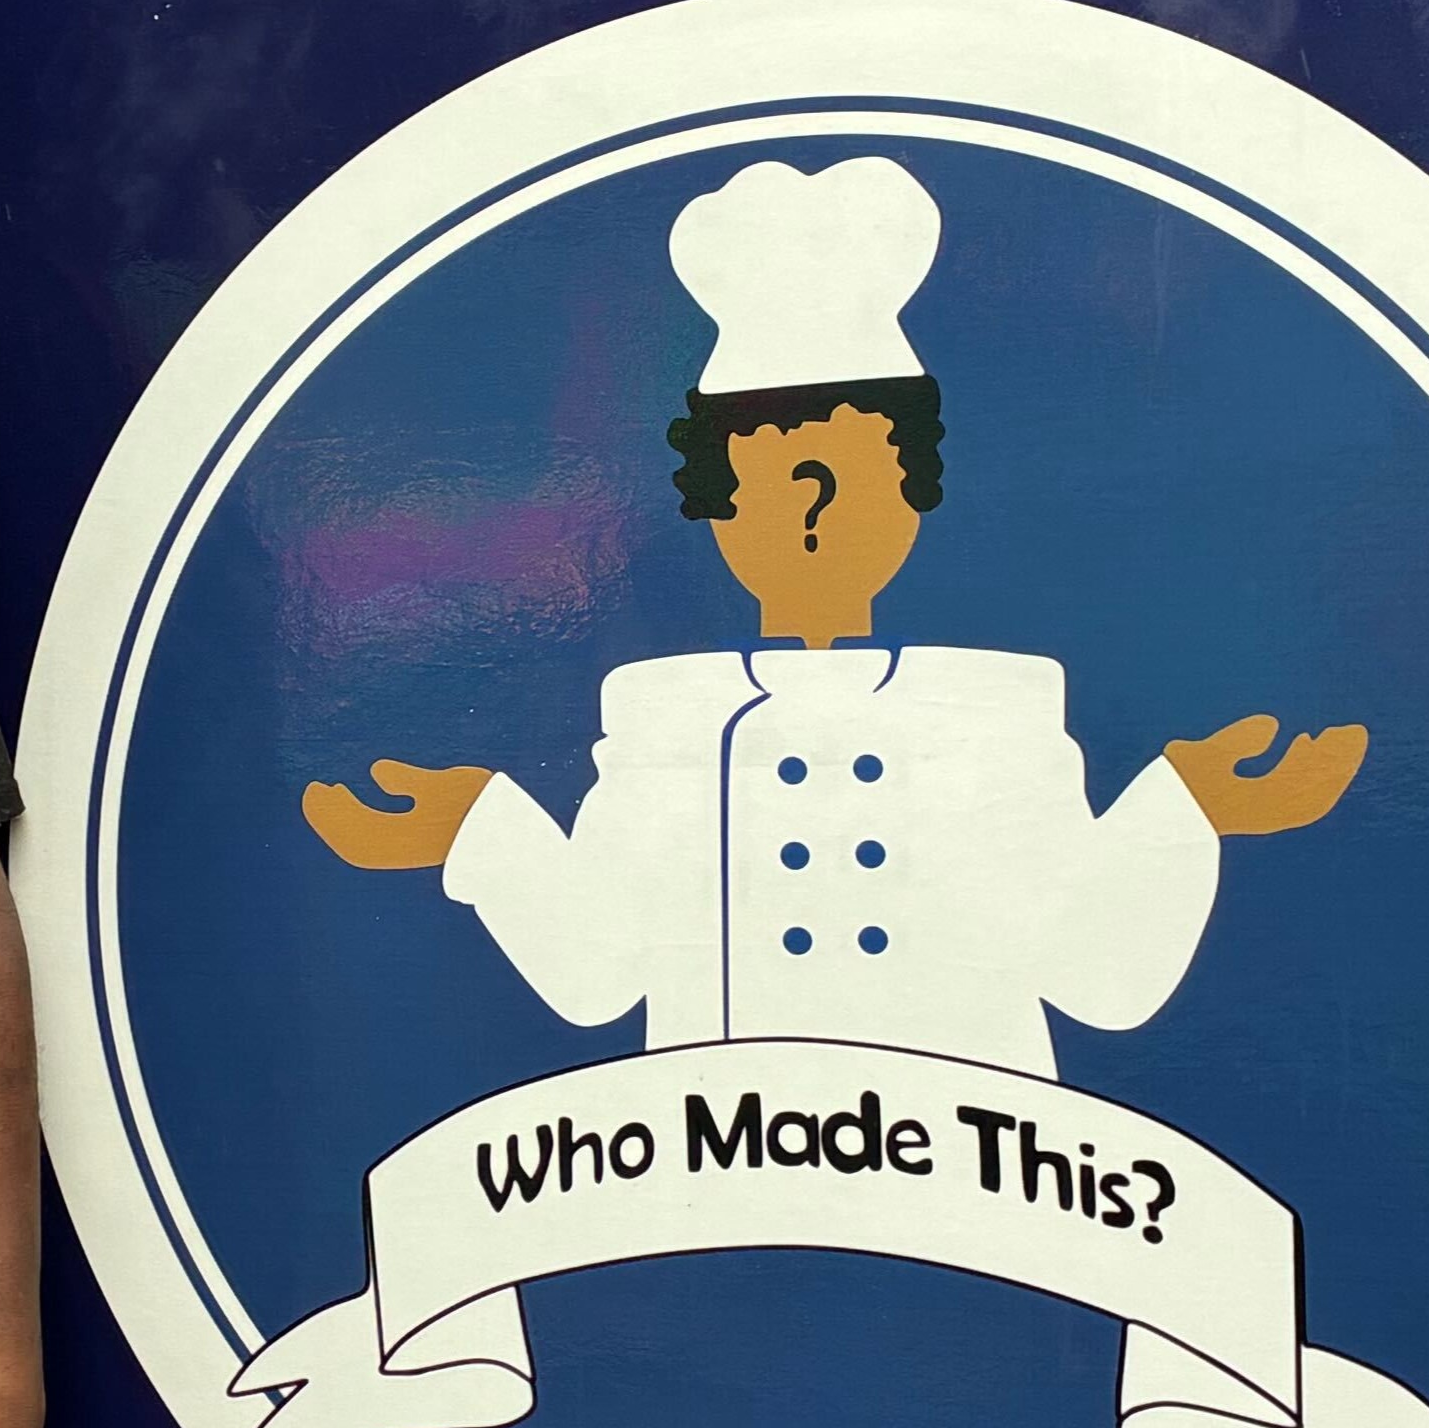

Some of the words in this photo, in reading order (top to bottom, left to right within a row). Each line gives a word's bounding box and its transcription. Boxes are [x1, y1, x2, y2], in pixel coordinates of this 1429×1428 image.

[792, 460, 837, 553] ?
[479, 1116, 655, 1213] Who
[684, 1091, 933, 1174] Made
[958, 1106, 1177, 1246] This?
